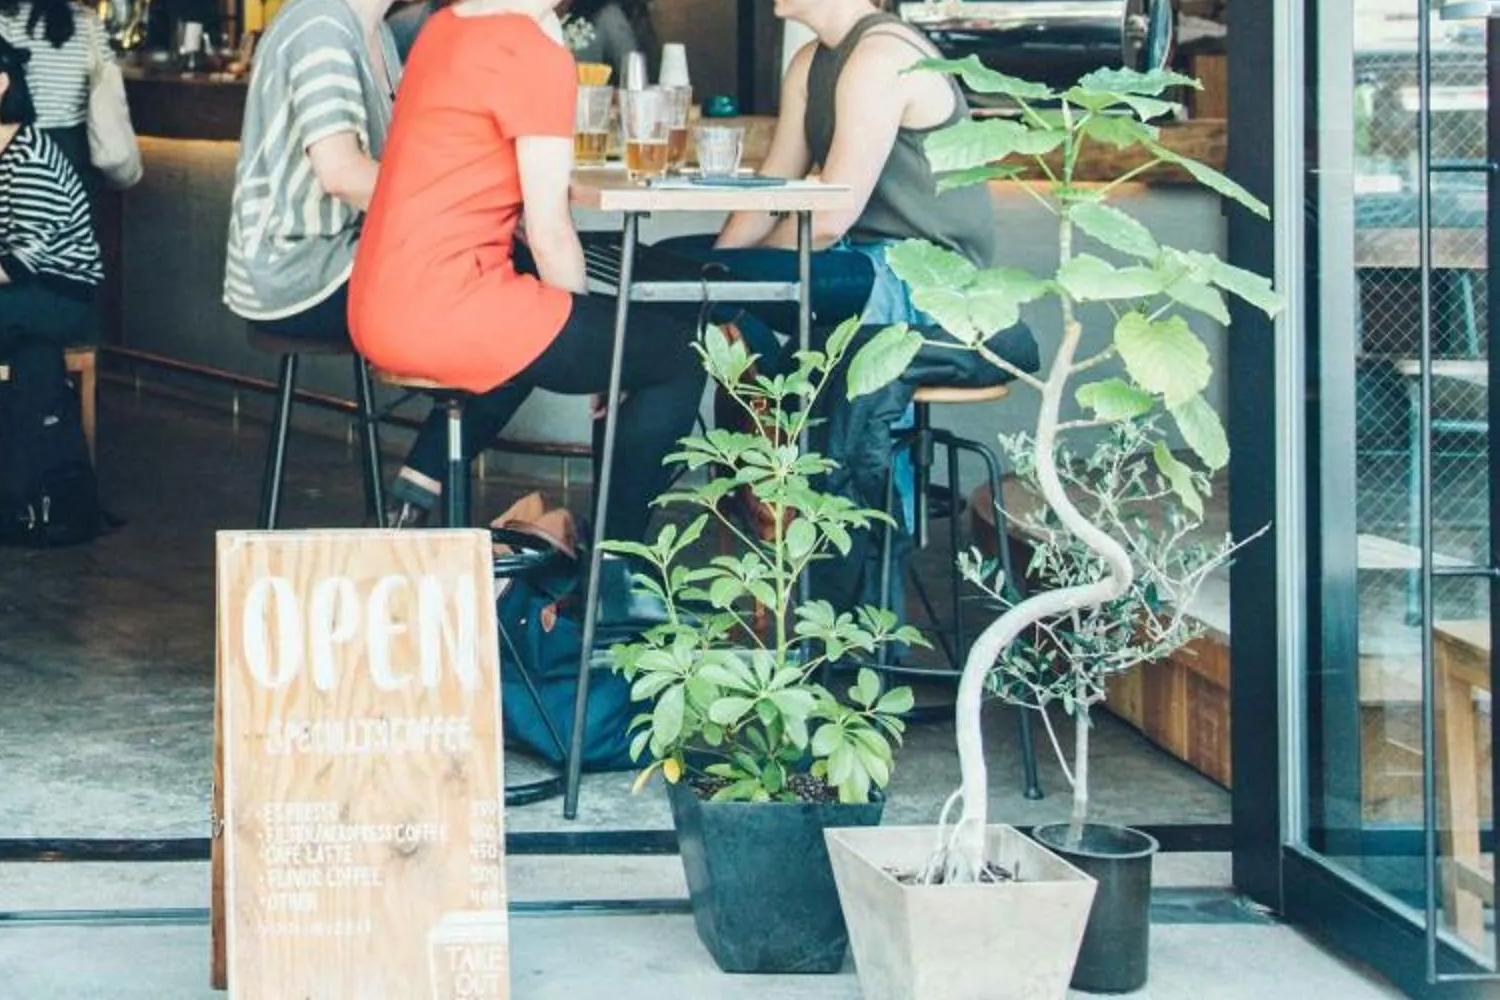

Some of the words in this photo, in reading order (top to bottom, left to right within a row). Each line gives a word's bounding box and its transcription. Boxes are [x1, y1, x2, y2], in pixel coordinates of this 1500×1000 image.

[243, 574, 481, 691] OPEN
[444, 945, 506, 972] TAKE
[455, 972, 501, 996] OUT
